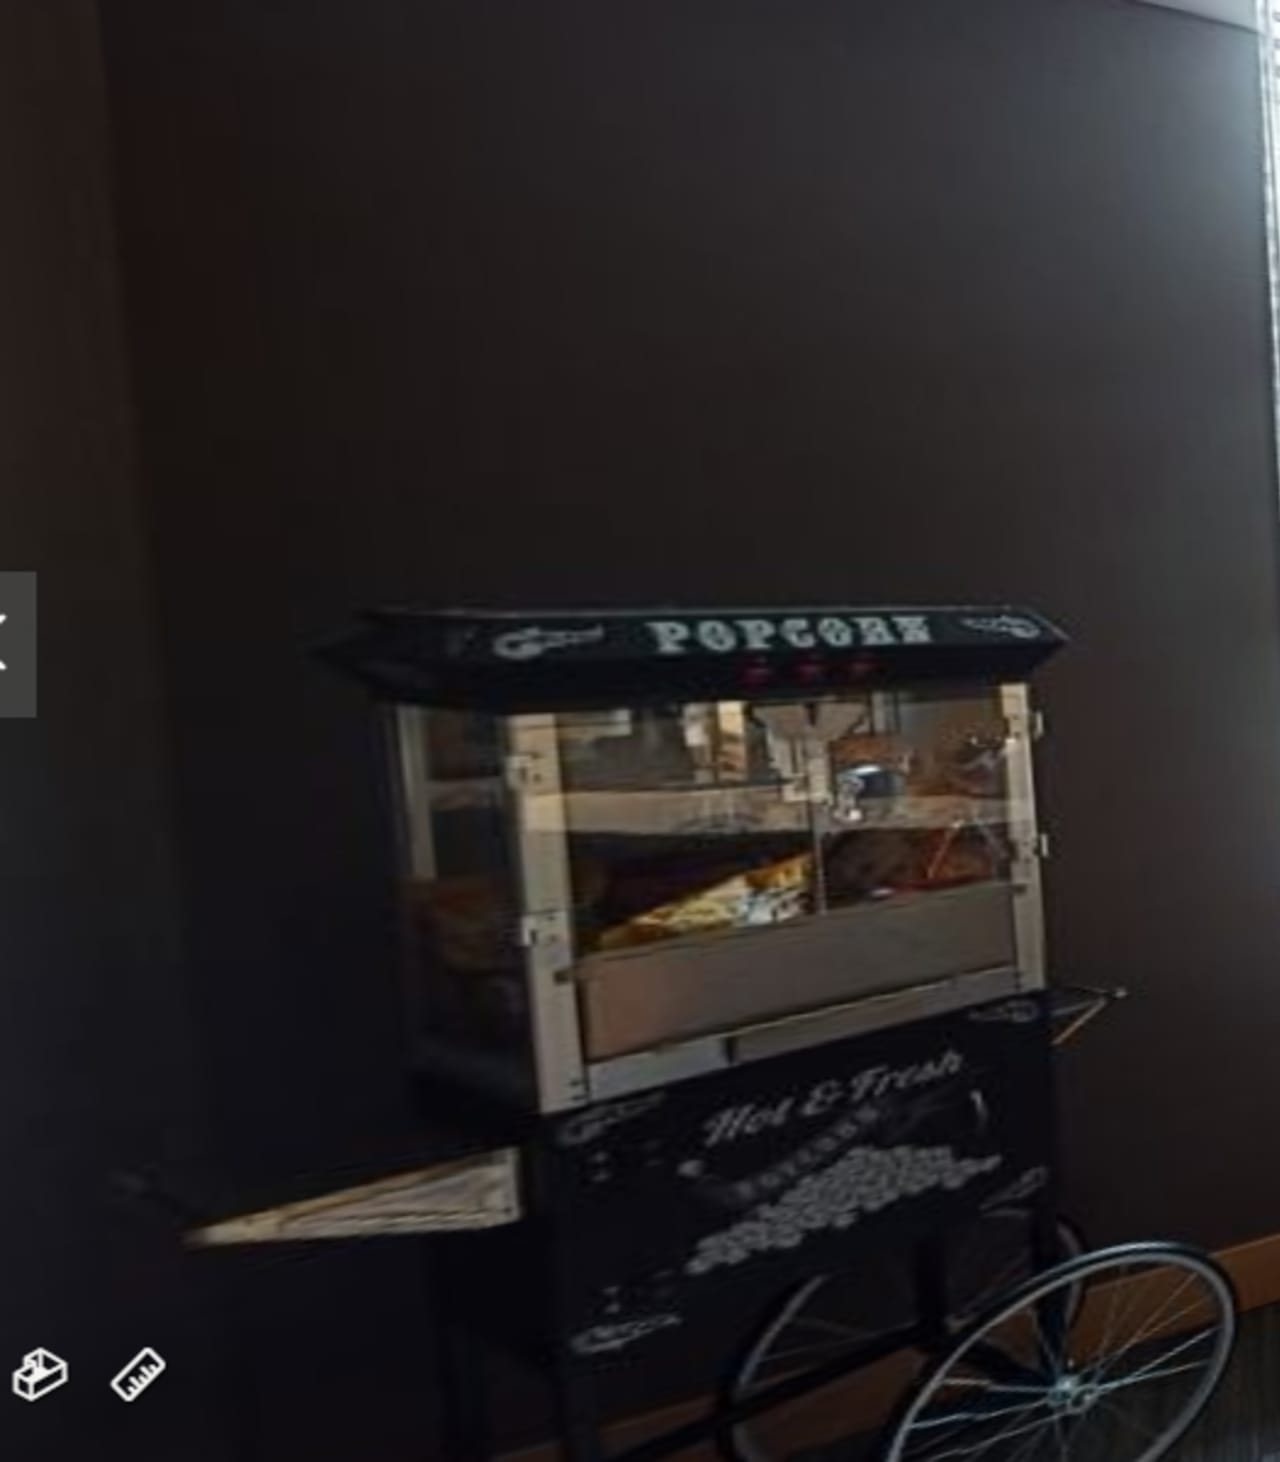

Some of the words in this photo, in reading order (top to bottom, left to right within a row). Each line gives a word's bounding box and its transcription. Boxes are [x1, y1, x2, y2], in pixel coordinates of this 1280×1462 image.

[646, 616, 931, 653] POPCORN
[703, 1099, 794, 1148] Hot
[848, 1049, 966, 1101] Fresh
